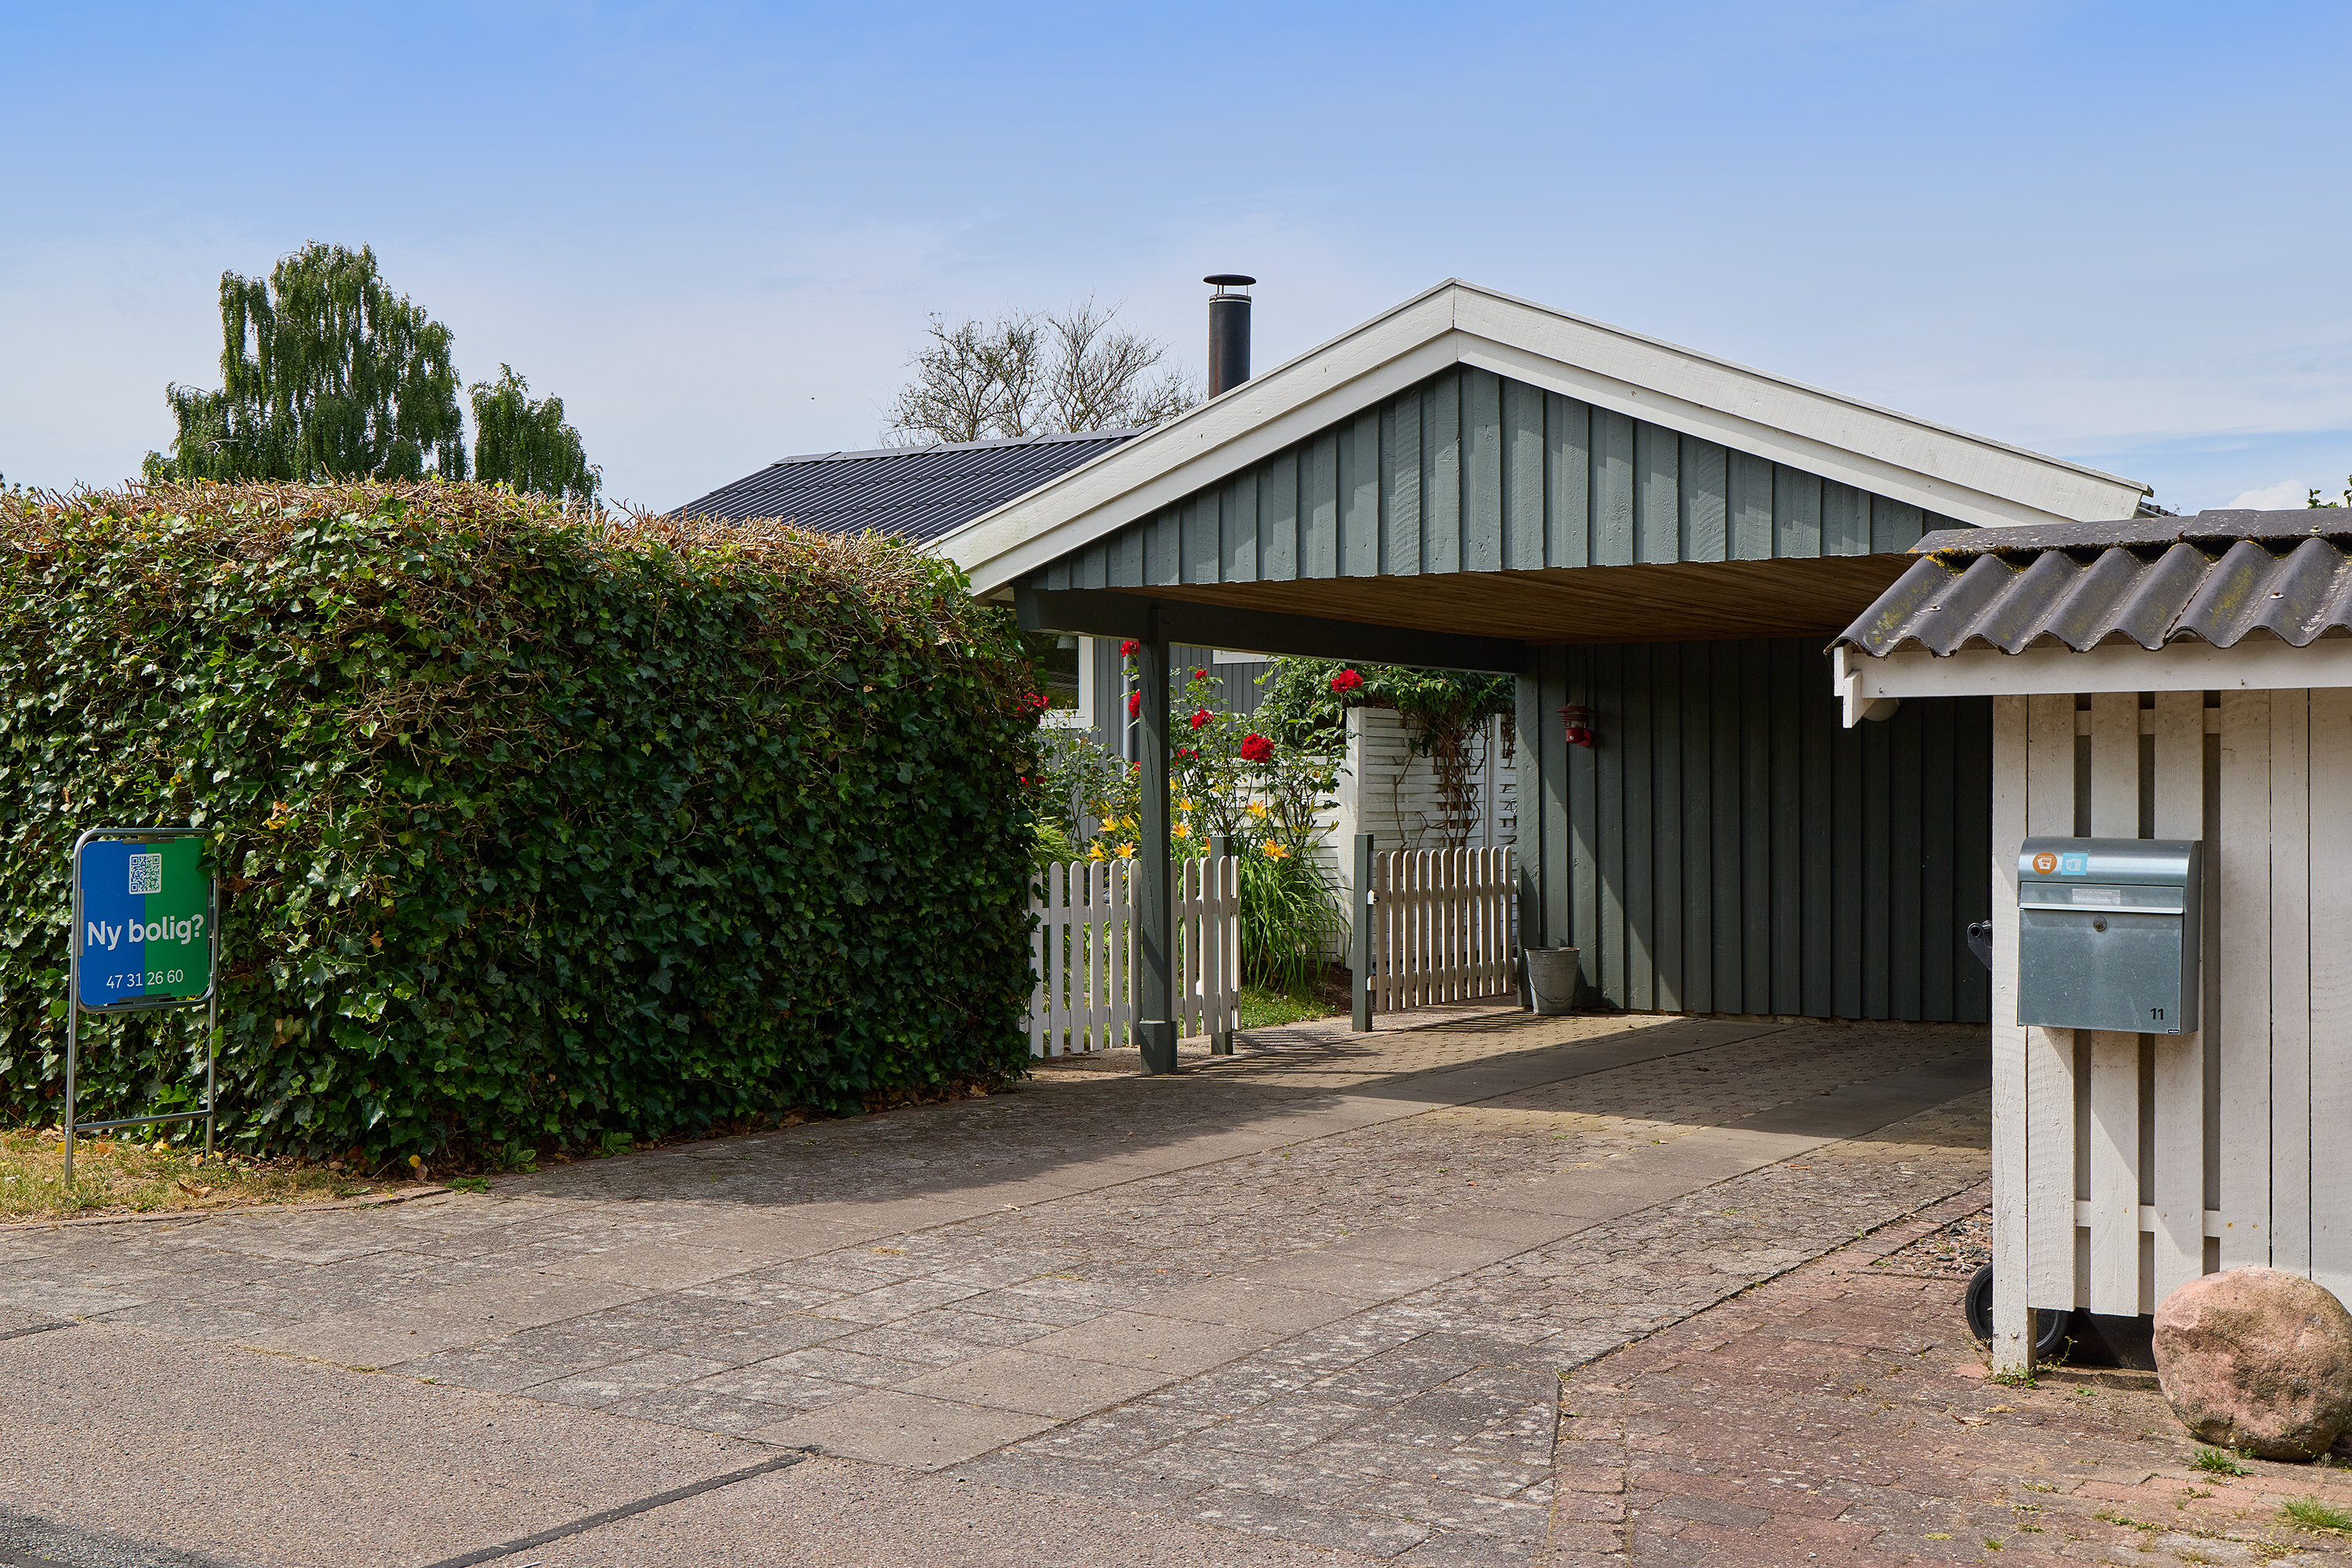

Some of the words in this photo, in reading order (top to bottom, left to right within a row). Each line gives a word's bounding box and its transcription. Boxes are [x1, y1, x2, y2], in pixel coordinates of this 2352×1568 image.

[88, 920, 122, 951] Ny
[129, 914, 205, 945] bolig?
[106, 975, 123, 989] 47
[126, 973, 143, 987] 31
[147, 971, 164, 985] 26
[167, 969, 183, 983] 60
[2151, 1007, 2164, 1020] 11
